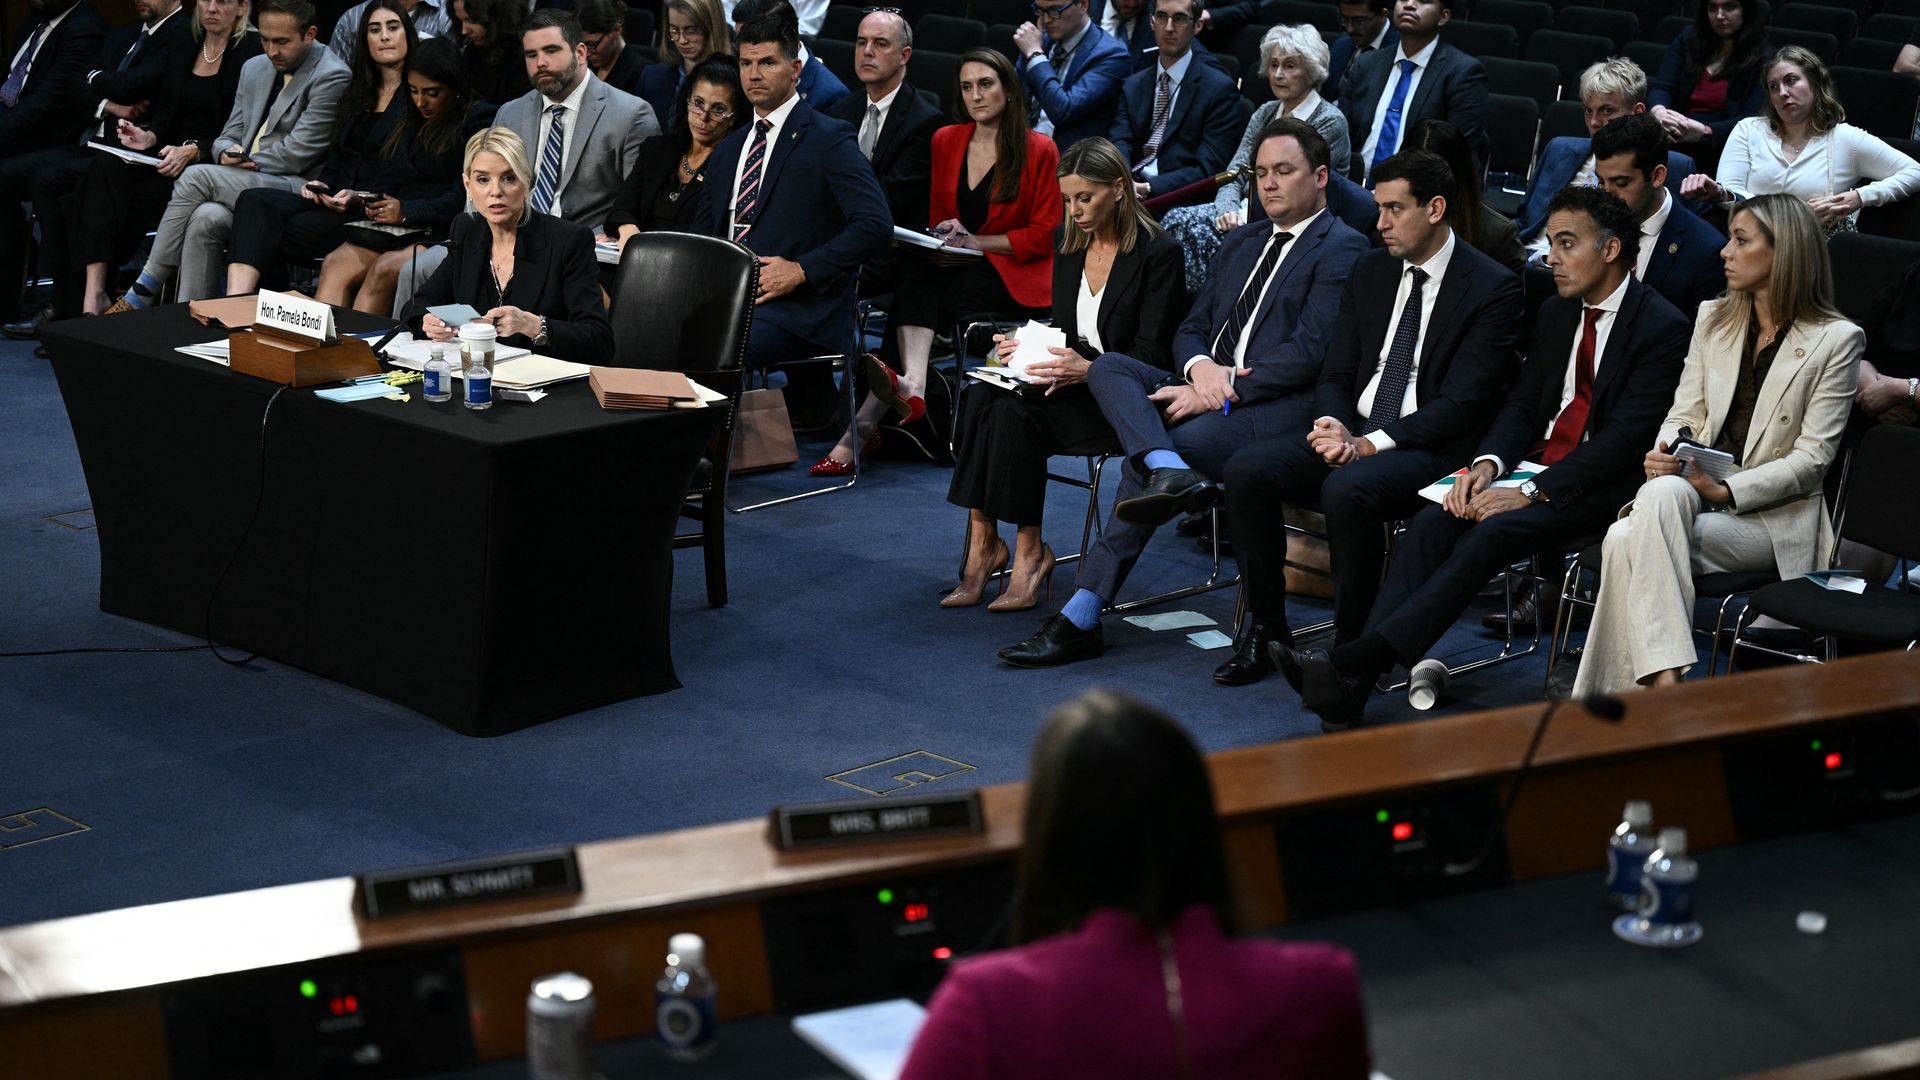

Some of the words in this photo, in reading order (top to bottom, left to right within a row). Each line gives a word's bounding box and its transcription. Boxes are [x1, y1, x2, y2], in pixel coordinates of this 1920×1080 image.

[261, 301, 275, 319] Hon.
[277, 305, 301, 325] Pamela
[301, 311, 322, 331] Bondi
